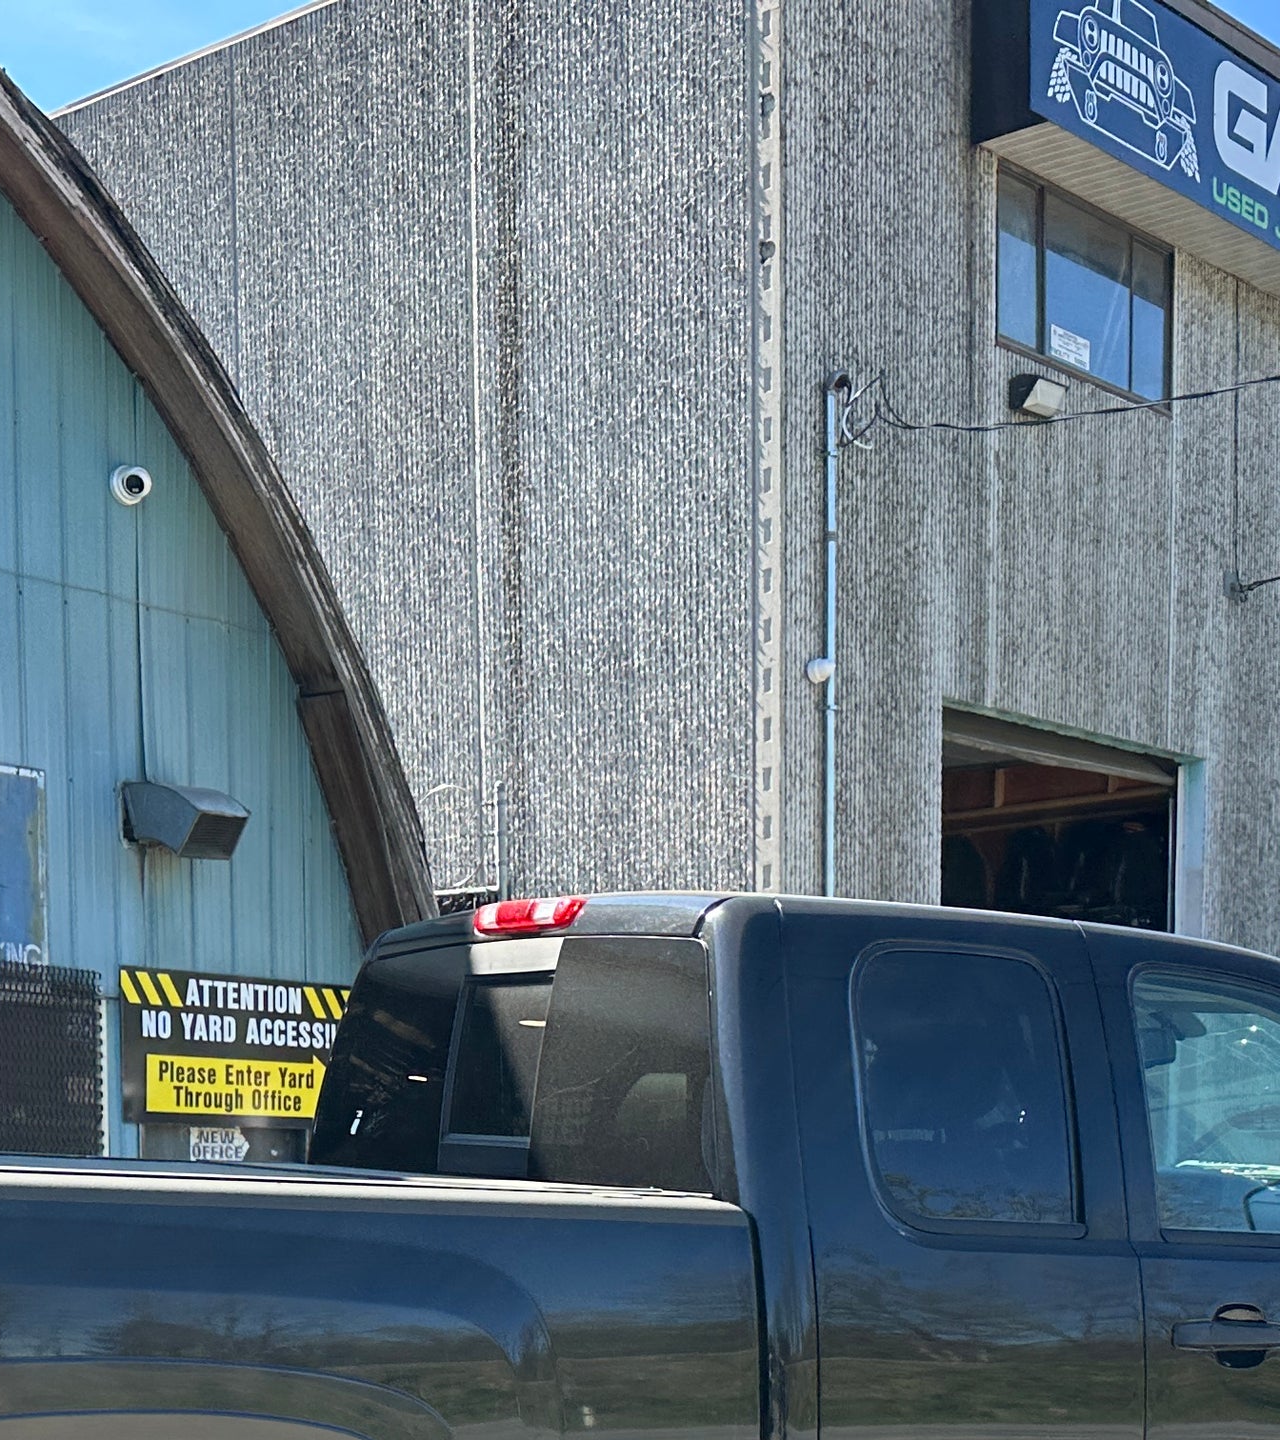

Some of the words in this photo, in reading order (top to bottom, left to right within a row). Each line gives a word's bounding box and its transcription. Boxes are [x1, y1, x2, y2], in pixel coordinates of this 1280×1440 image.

[1212, 176, 1269, 230] USED
[185, 978, 303, 1015] ATTENTION
[141, 1009, 172, 1039] NO
[180, 1012, 237, 1044] YARD
[158, 1060, 217, 1085] Please
[225, 1064, 271, 1088] Enter
[278, 1066, 315, 1090] Yard
[172, 1085, 244, 1114] Through
[252, 1088, 302, 1112] Office
[191, 1143, 244, 1160] OFFICE
[198, 1130, 235, 1144] NEW
